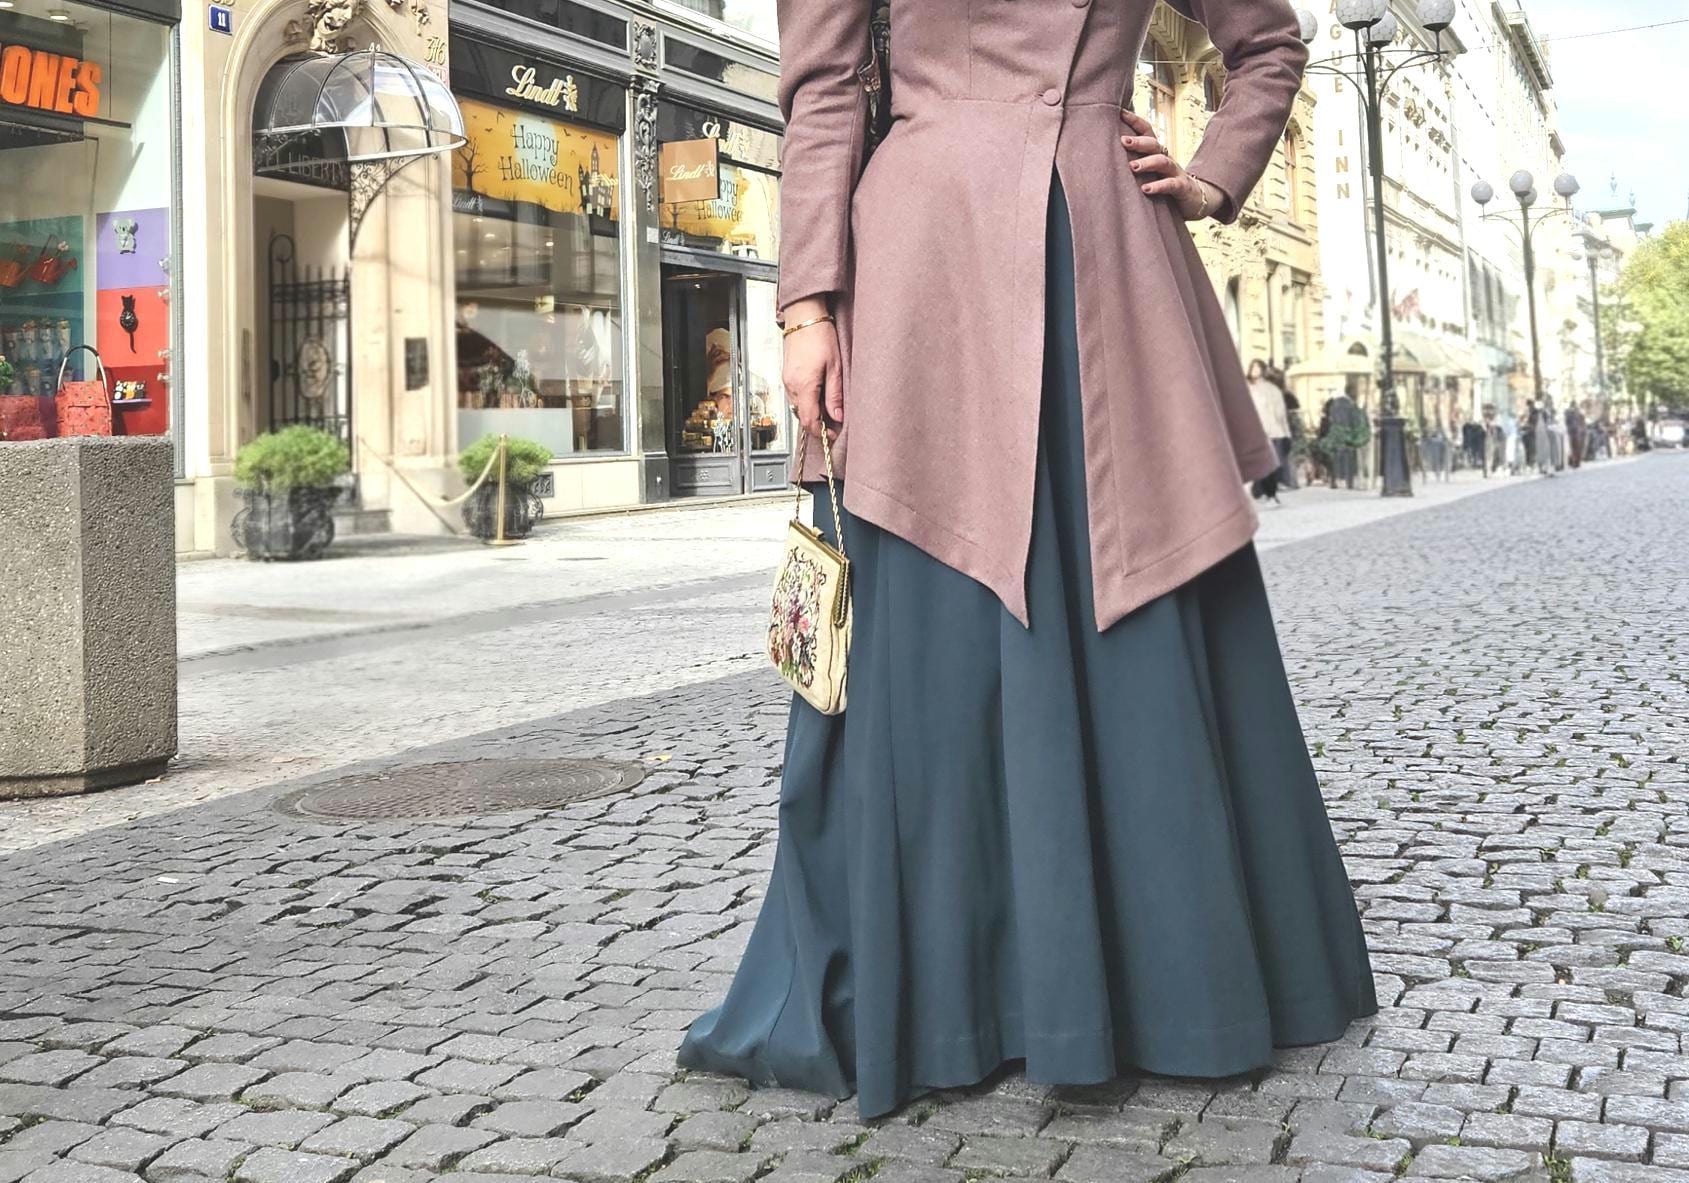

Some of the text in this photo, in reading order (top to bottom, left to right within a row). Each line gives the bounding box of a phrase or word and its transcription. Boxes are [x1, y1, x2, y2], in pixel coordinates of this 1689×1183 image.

[0, 44, 103, 117] ONES
[505, 65, 565, 106] Lindt
[511, 124, 560, 166] Happy
[1336, 129, 1350, 200] INN
[498, 155, 574, 196] Halloween
[666, 163, 706, 180] Lindt
